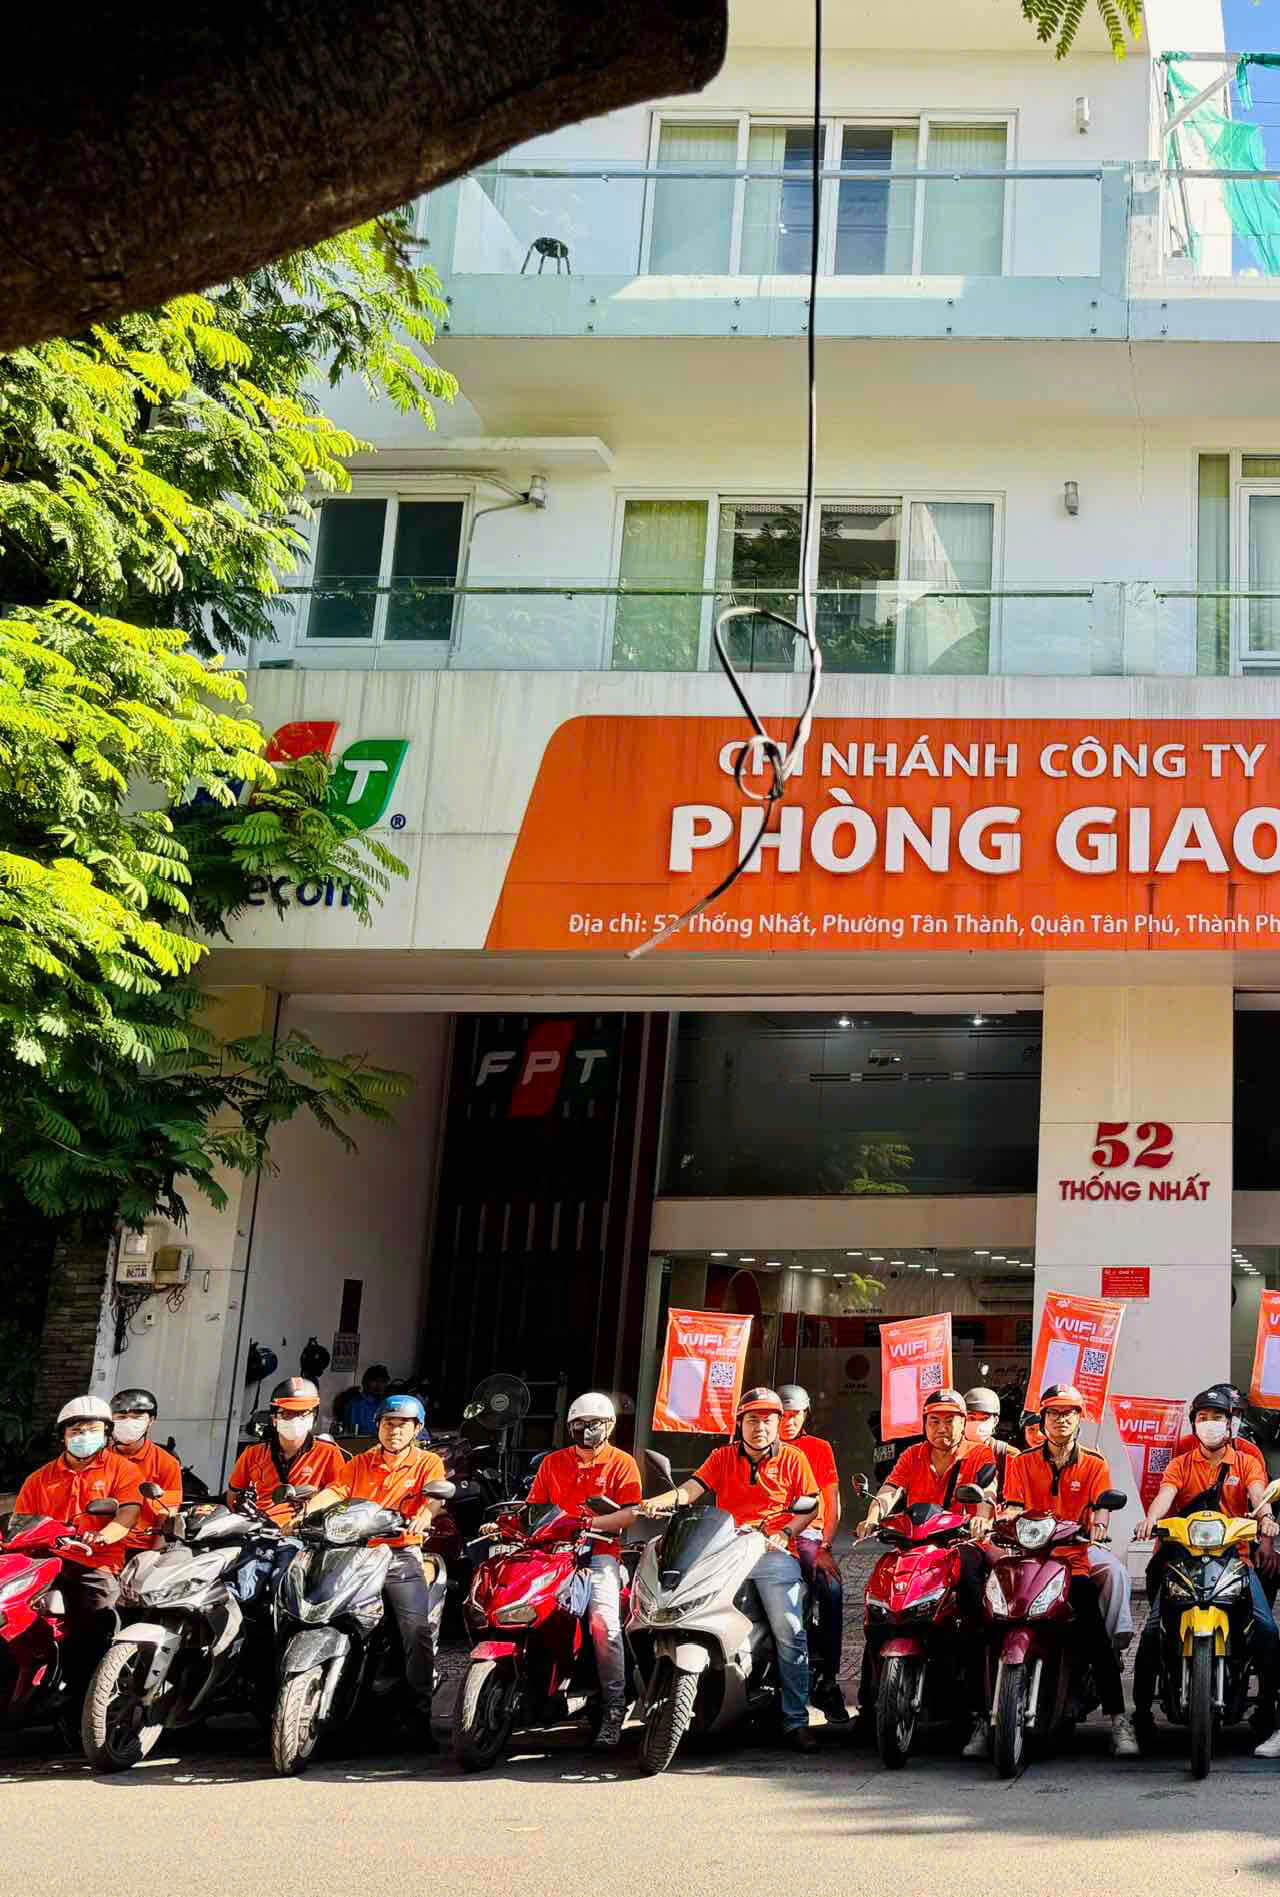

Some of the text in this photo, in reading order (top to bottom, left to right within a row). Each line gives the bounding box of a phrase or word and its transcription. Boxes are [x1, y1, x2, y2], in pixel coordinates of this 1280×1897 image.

[821, 735, 1018, 777] NHÁNH
[1040, 736, 1186, 778] CÔNG
[1203, 743, 1265, 777] TY
[668, 787, 1021, 874] PHÒNG
[568, 913, 603, 936] Địa
[609, 912, 647, 933] chỉ:
[653, 914, 680, 933] 52
[688, 911, 753, 938] Thống
[759, 912, 817, 937] Nhất,
[823, 913, 905, 938] Phường
[912, 914, 948, 933] Tân
[956, 914, 1025, 937] Thành,
[1030, 914, 1085, 937] Quận
[1091, 914, 1128, 933] Tân
[1135, 914, 1180, 937] Phú,
[1188, 914, 1250, 933] Thành
[475, 1050, 608, 1087] FPT
[1092, 1121, 1174, 1169] 52
[1058, 1171, 1211, 1201] THỐNG NHẤT
[1055, 1316, 1097, 1334] WIFI
[888, 1339, 929, 1358] WIFI
[1119, 1418, 1160, 1433] WIFI
